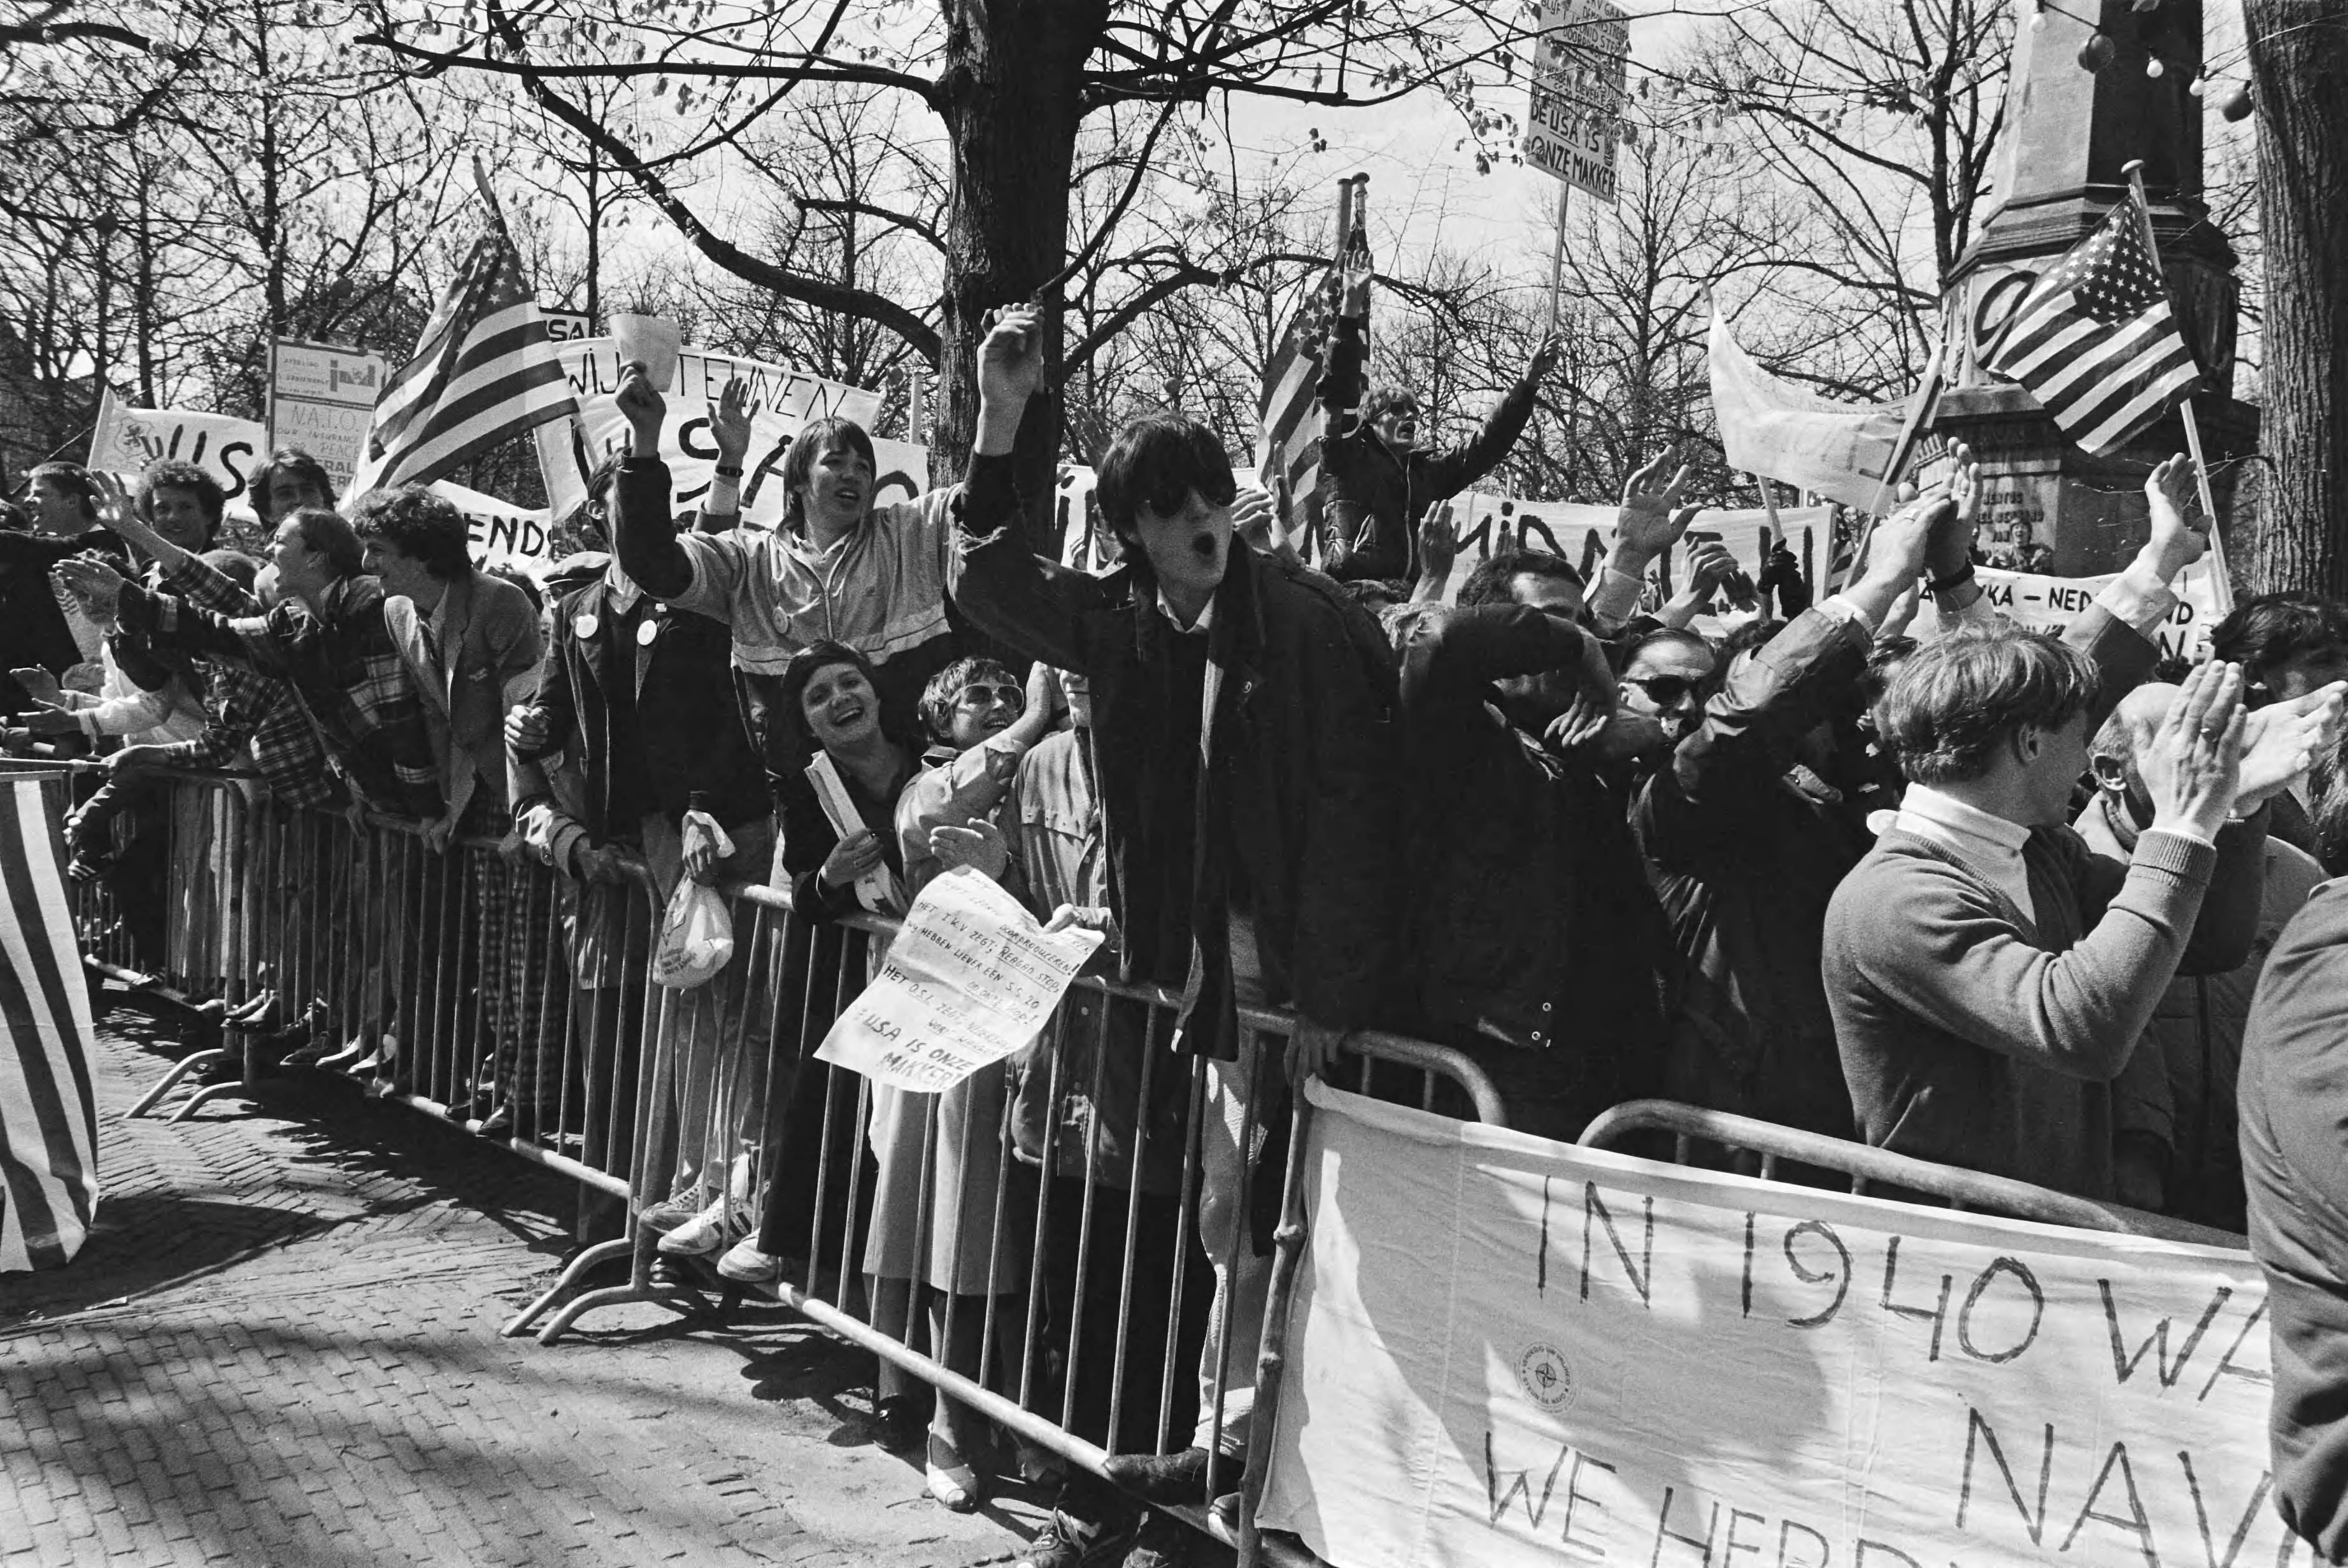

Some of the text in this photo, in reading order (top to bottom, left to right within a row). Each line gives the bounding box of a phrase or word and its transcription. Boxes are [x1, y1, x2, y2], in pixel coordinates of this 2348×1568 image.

[1549, 109, 1579, 143] USA
[1572, 152, 1616, 199] MAKKER
[883, 963, 910, 985] HET
[920, 927, 953, 951] HEBBEN
[983, 967, 1004, 982] EEN
[906, 1038, 927, 1053] IS
[1537, 1174, 1654, 1310] IN
[1742, 1210, 2045, 1364] 1940
[1486, 1431, 1618, 1557] WE
